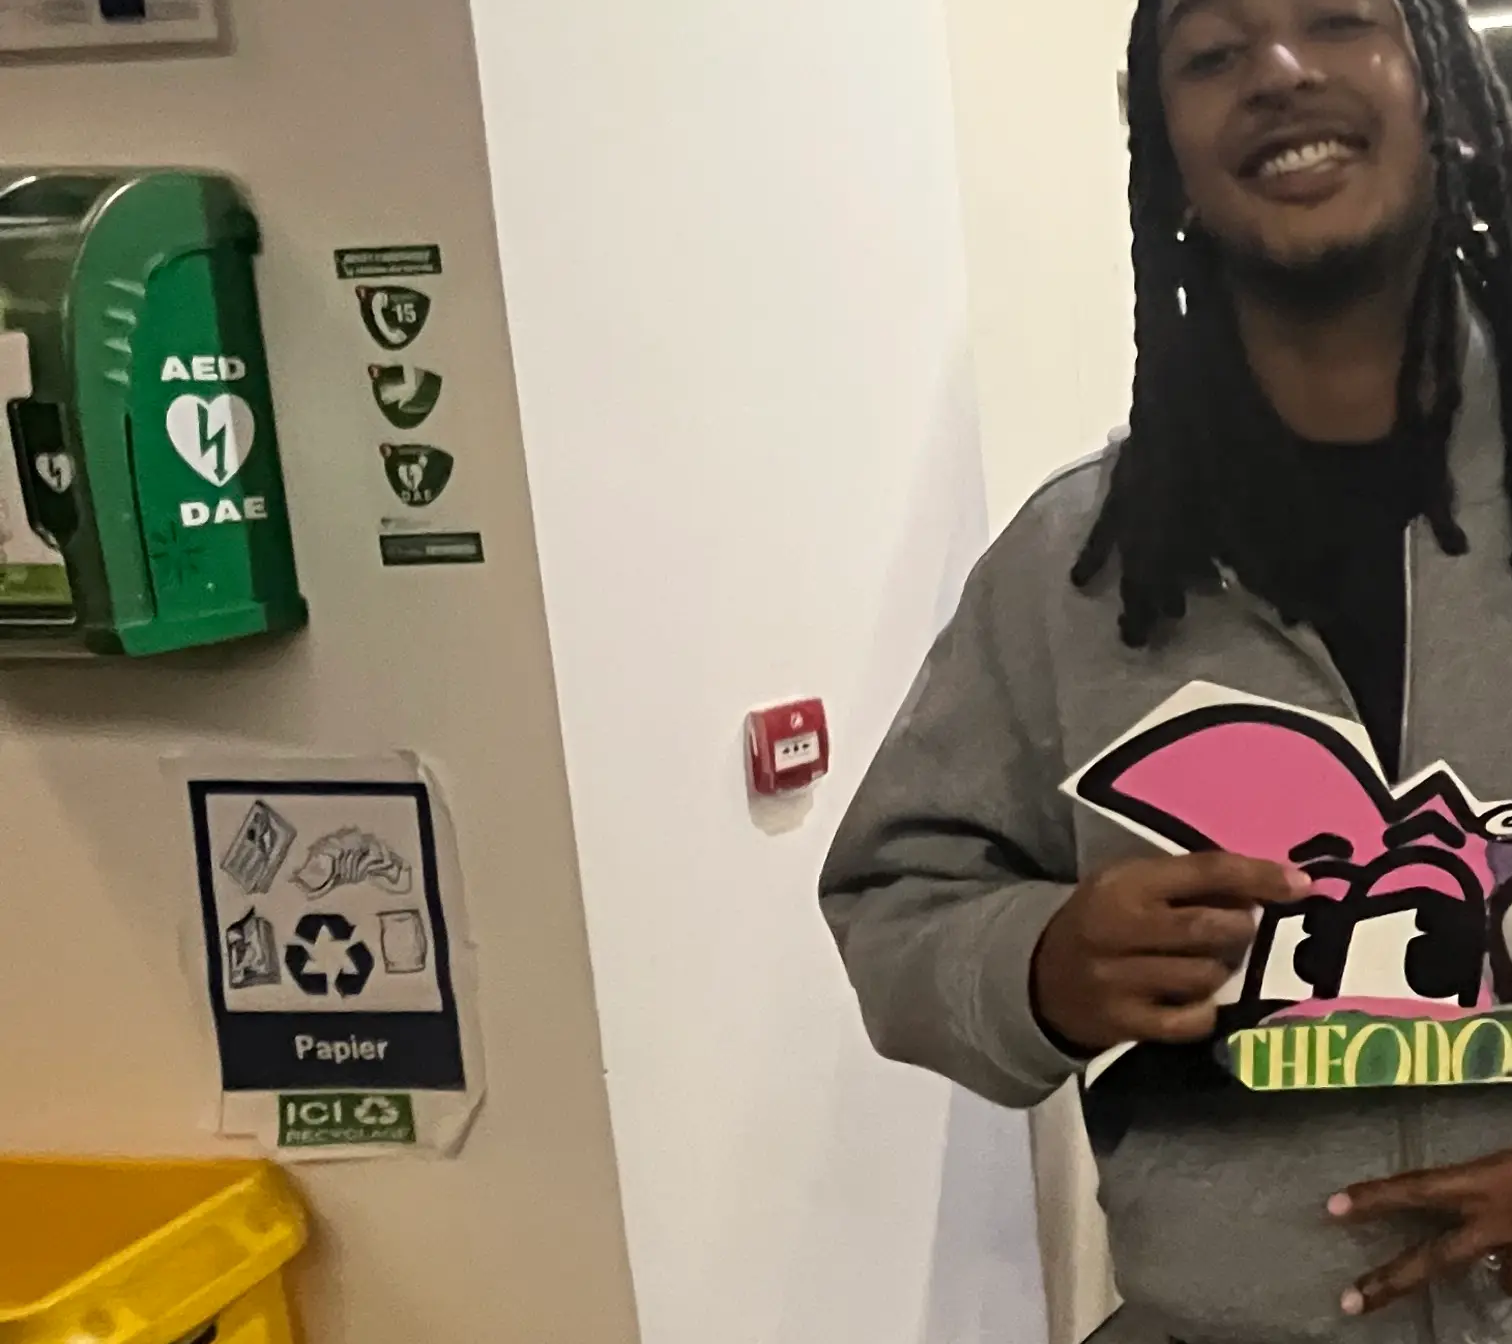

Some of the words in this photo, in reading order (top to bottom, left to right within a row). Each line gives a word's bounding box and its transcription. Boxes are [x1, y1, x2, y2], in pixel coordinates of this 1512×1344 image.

[391, 303, 417, 323] 15
[161, 355, 246, 382] AED
[180, 496, 268, 528] DAE
[294, 1033, 388, 1064] Papier
[286, 1101, 342, 1125] ICI
